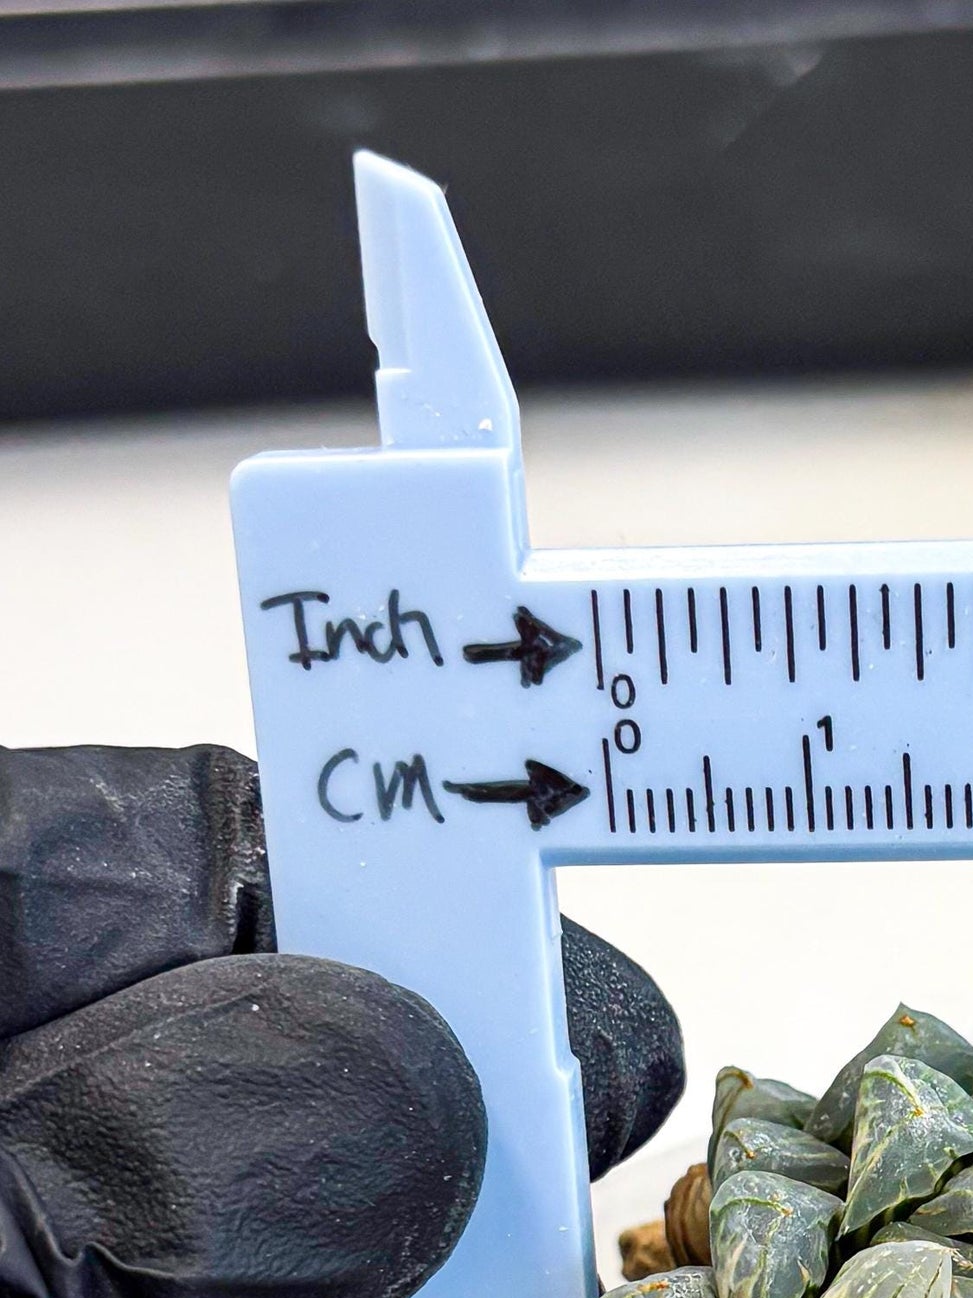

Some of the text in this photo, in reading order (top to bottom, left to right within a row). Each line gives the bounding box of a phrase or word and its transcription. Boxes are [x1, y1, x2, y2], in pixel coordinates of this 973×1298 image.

[259, 588, 445, 672] Inch
[610, 673, 636, 710] 0
[613, 718, 642, 755] 0
[816, 715, 834, 752] 1
